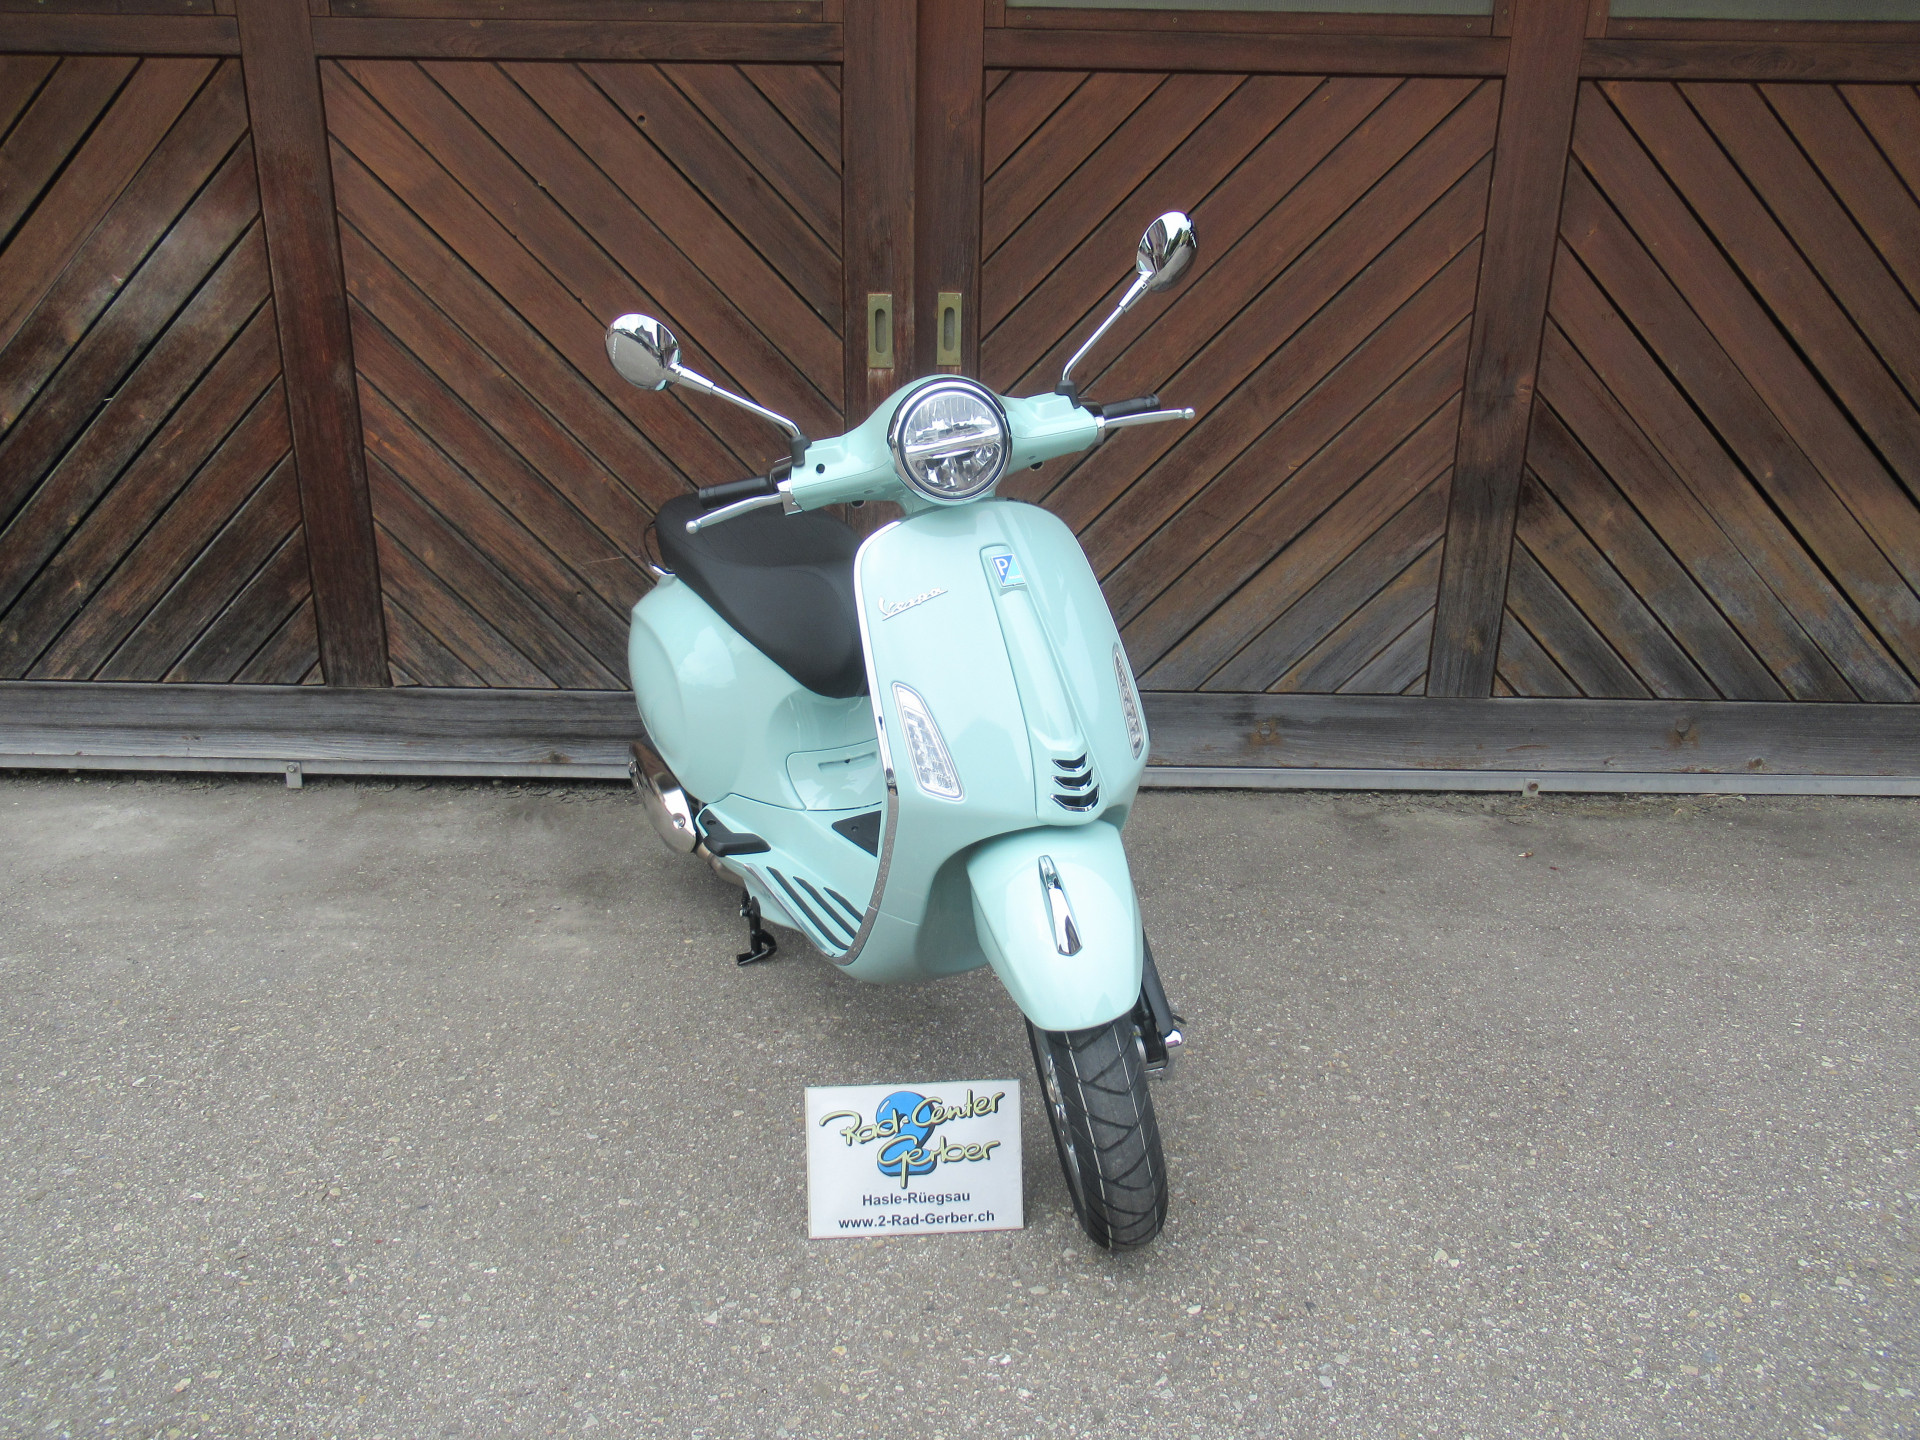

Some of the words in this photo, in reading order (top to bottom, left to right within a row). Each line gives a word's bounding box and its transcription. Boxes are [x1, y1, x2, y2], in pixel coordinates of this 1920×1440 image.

[878, 587, 948, 621] Vespa
[877, 1135, 1001, 1189] Gerber
[862, 1192, 971, 1207] Hasle-Rüegsau
[838, 1210, 995, 1229] www.2-Rad-Gerber.ch
